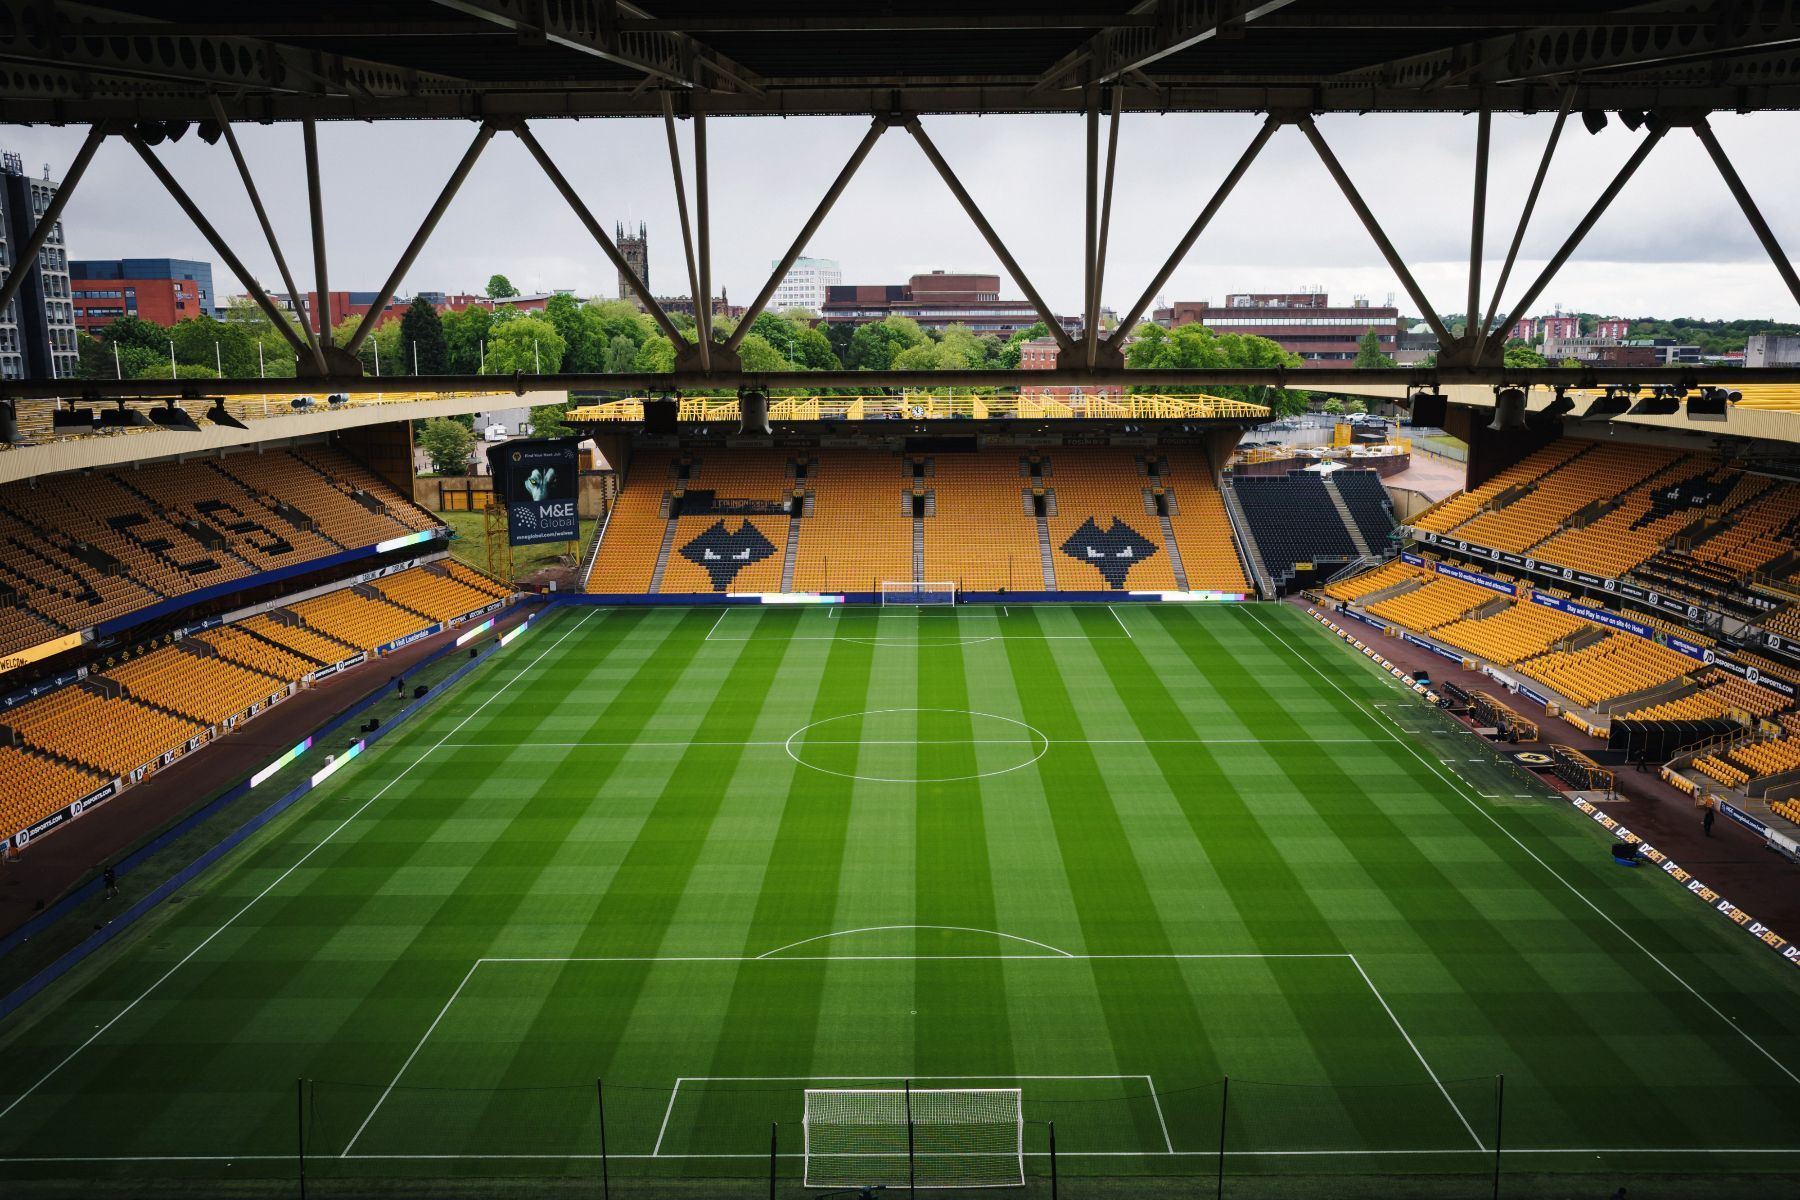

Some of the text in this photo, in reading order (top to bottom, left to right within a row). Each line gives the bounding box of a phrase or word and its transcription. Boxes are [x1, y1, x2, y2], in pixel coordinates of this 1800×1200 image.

[539, 503, 574, 518] M&E
[540, 517, 575, 529] Global
[1567, 604, 1576, 613] Stay
[1586, 610, 1595, 619] Play
[1632, 625, 1644, 634] Hotel
[1715, 658, 1746, 674] JDSPORTS.COM
[1758, 676, 1793, 694] JDSPORTS.COM
[82, 788, 112, 808] JDSPORTS.COM
[29, 815, 62, 836] JDSPORTS.COM
